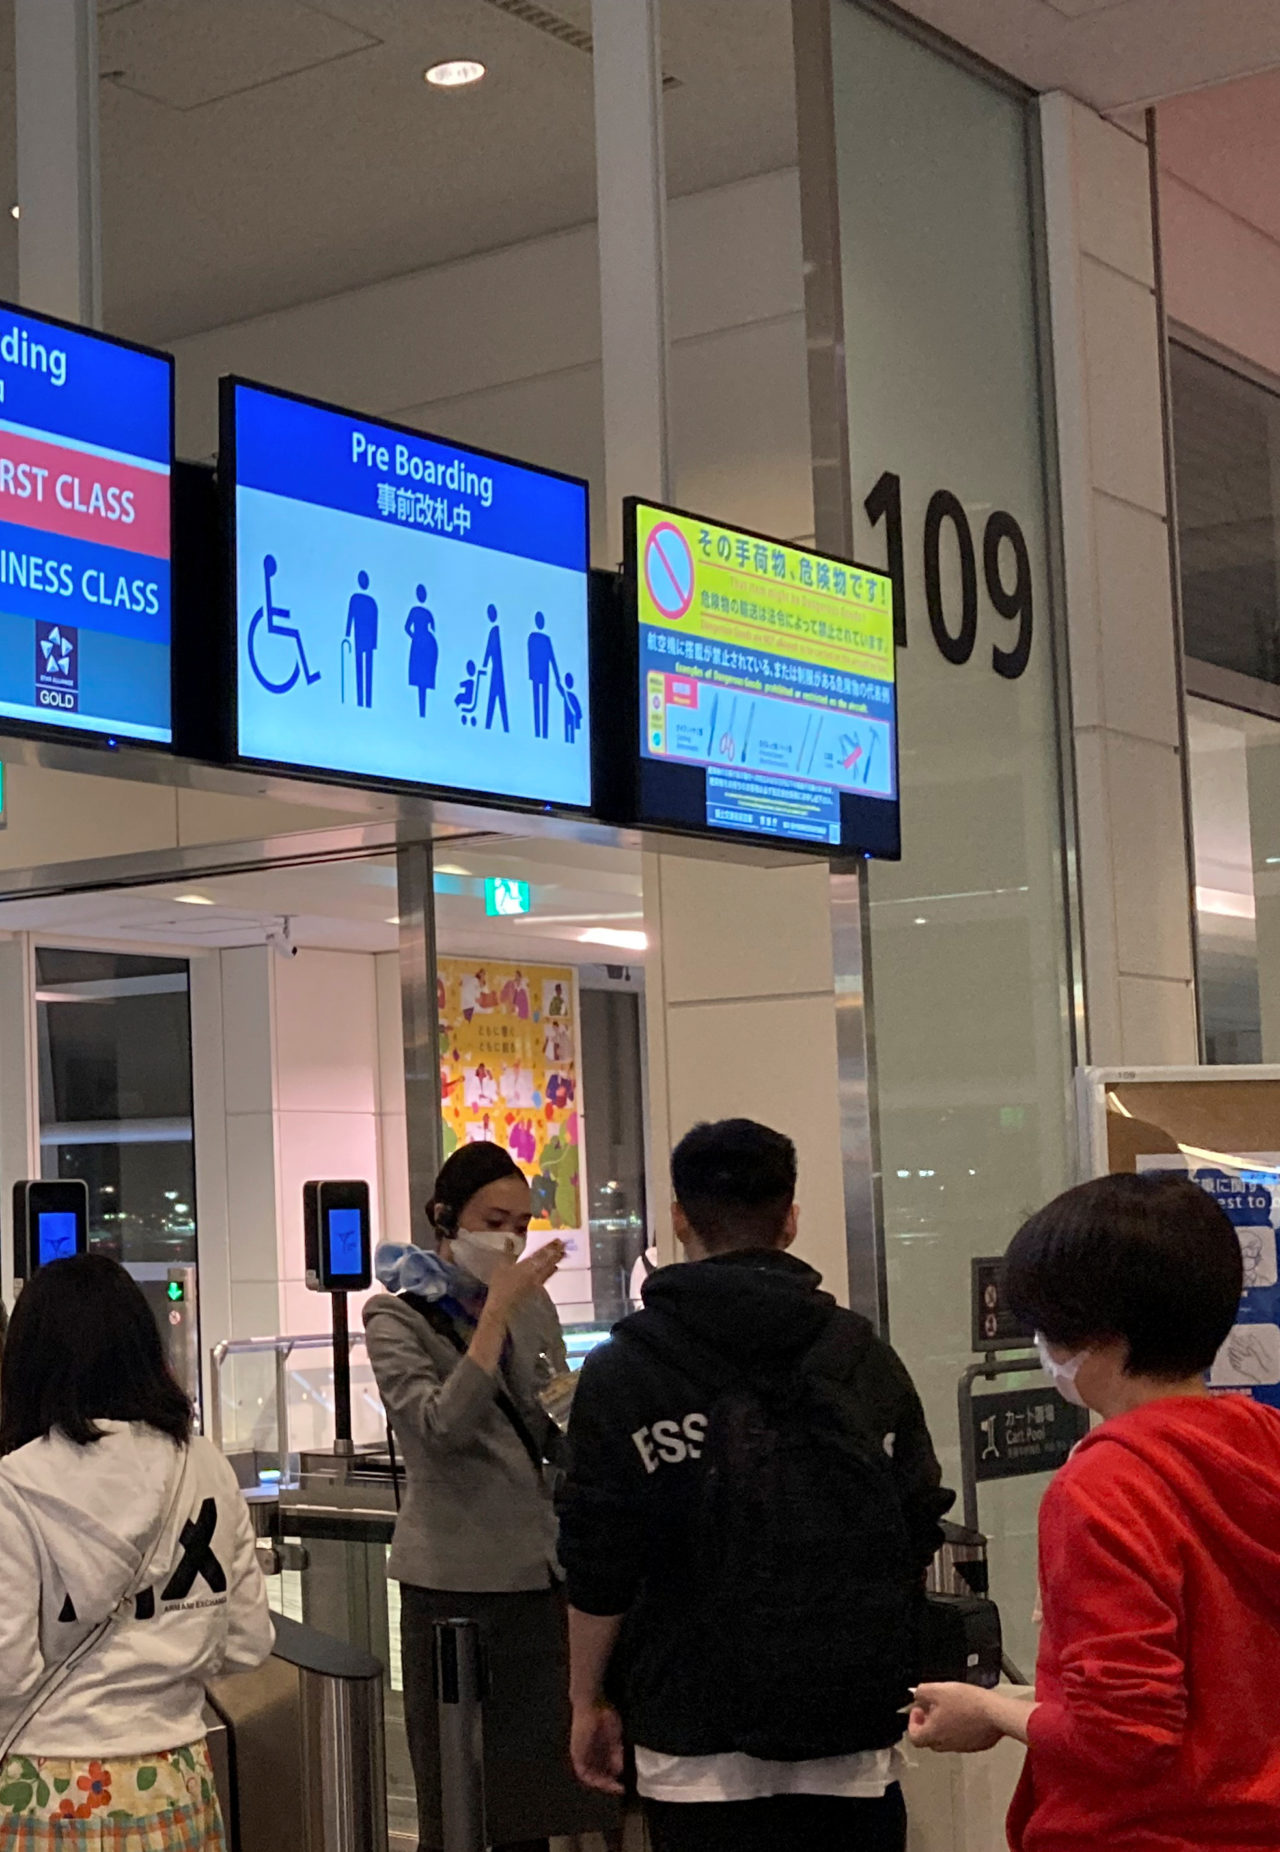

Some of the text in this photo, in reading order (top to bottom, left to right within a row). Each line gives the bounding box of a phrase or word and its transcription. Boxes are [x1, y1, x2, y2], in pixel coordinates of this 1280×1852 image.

[351, 431, 493, 507] Pre Boarding
[56, 473, 136, 524] CLASS
[376, 482, 471, 535] 事前改札中
[82, 568, 160, 616] CLASS
[864, 470, 1033, 680] 109
[40, 689, 74, 709] GOLD
[1247, 1196, 1266, 1209] to
